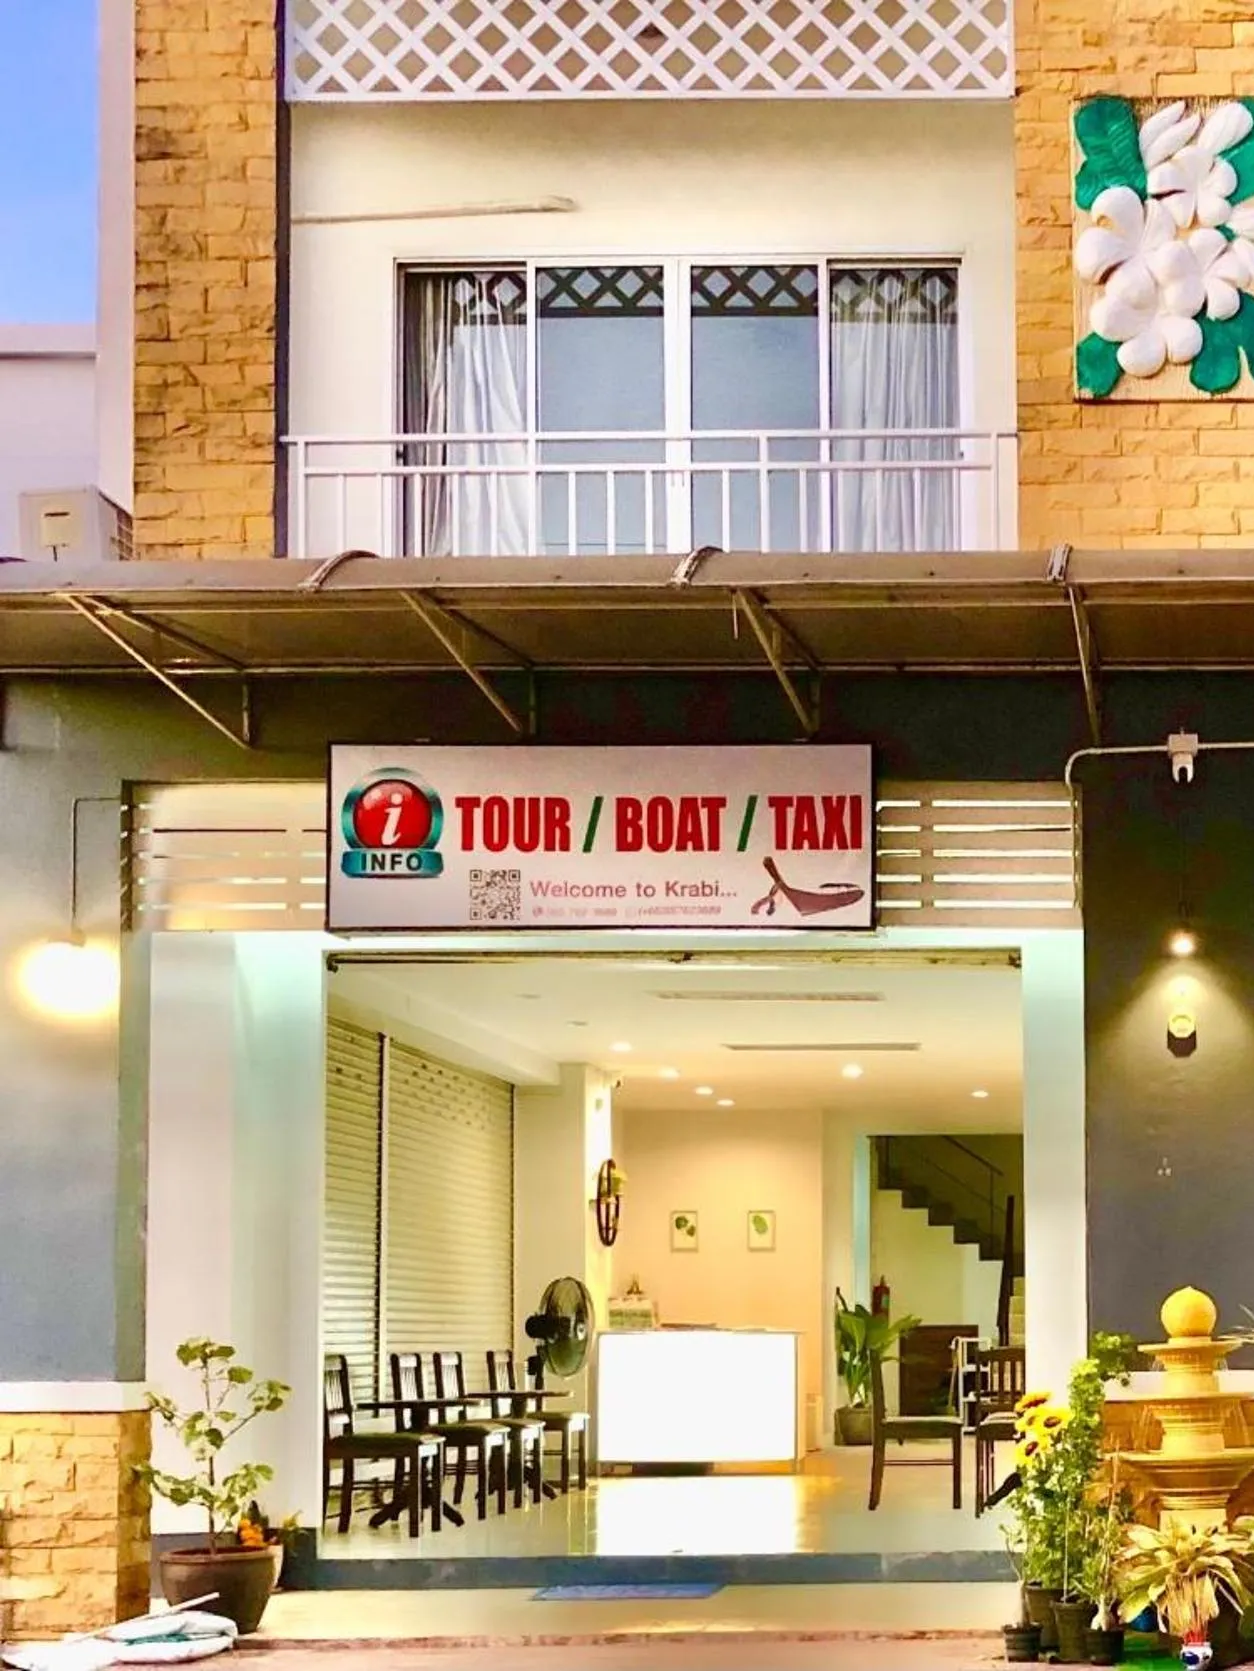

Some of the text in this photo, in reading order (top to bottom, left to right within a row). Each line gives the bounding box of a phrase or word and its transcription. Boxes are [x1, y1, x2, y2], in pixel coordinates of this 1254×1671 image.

[454, 795, 571, 853] TOUR
[615, 795, 727, 853] BOAT
[767, 794, 863, 851] TAXI
[360, 853, 424, 872] INFO
[530, 879, 738, 898] Welcome to Krabi...
